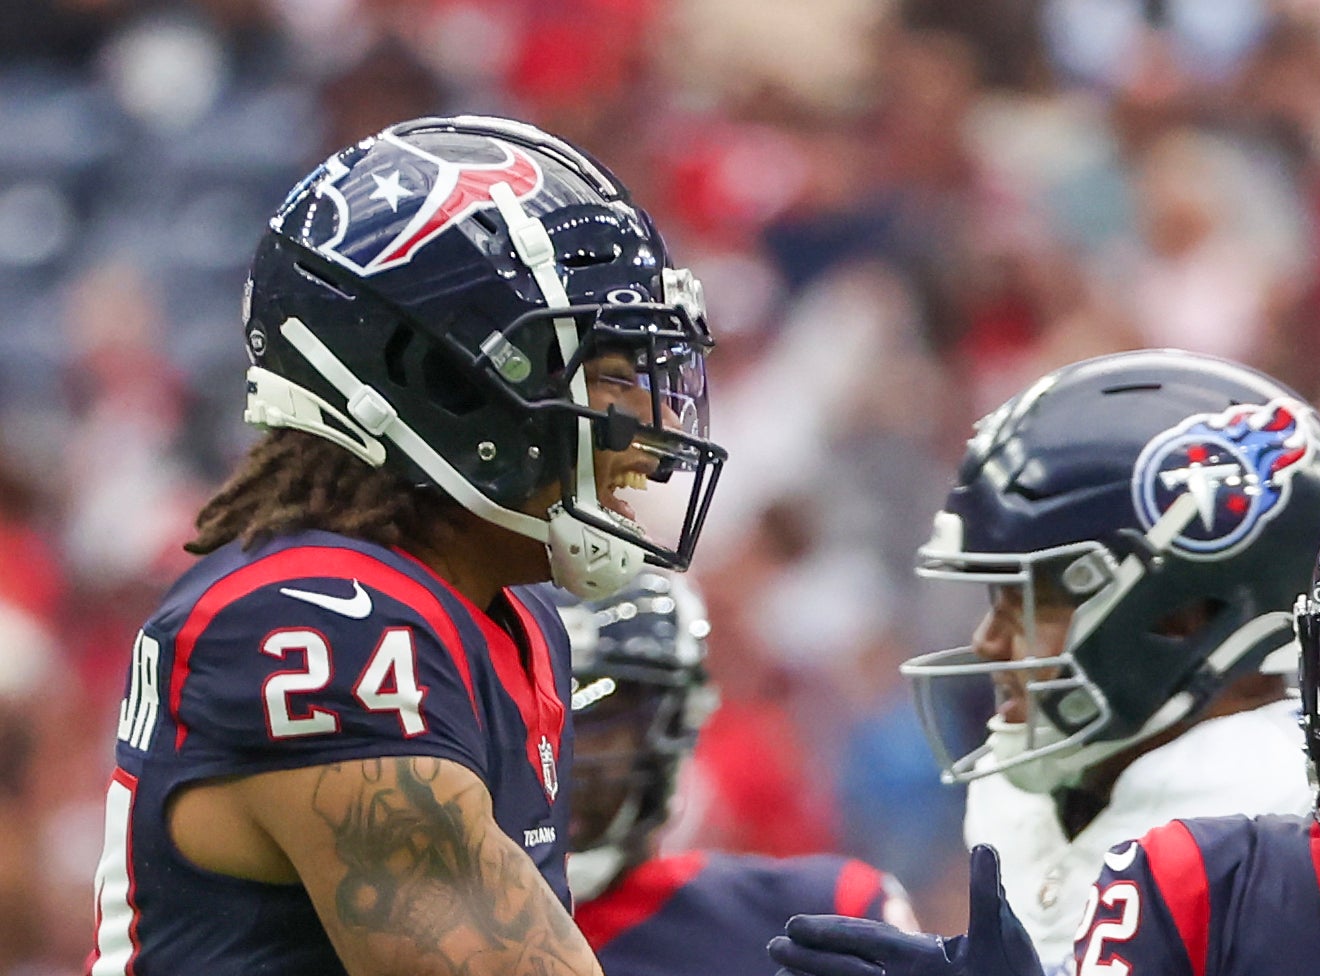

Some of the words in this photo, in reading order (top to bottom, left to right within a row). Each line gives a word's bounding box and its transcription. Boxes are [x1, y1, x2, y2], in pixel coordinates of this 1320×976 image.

[117, 628, 160, 752] JR
[258, 625, 430, 739] 24
[523, 826, 557, 848] TEXANS
